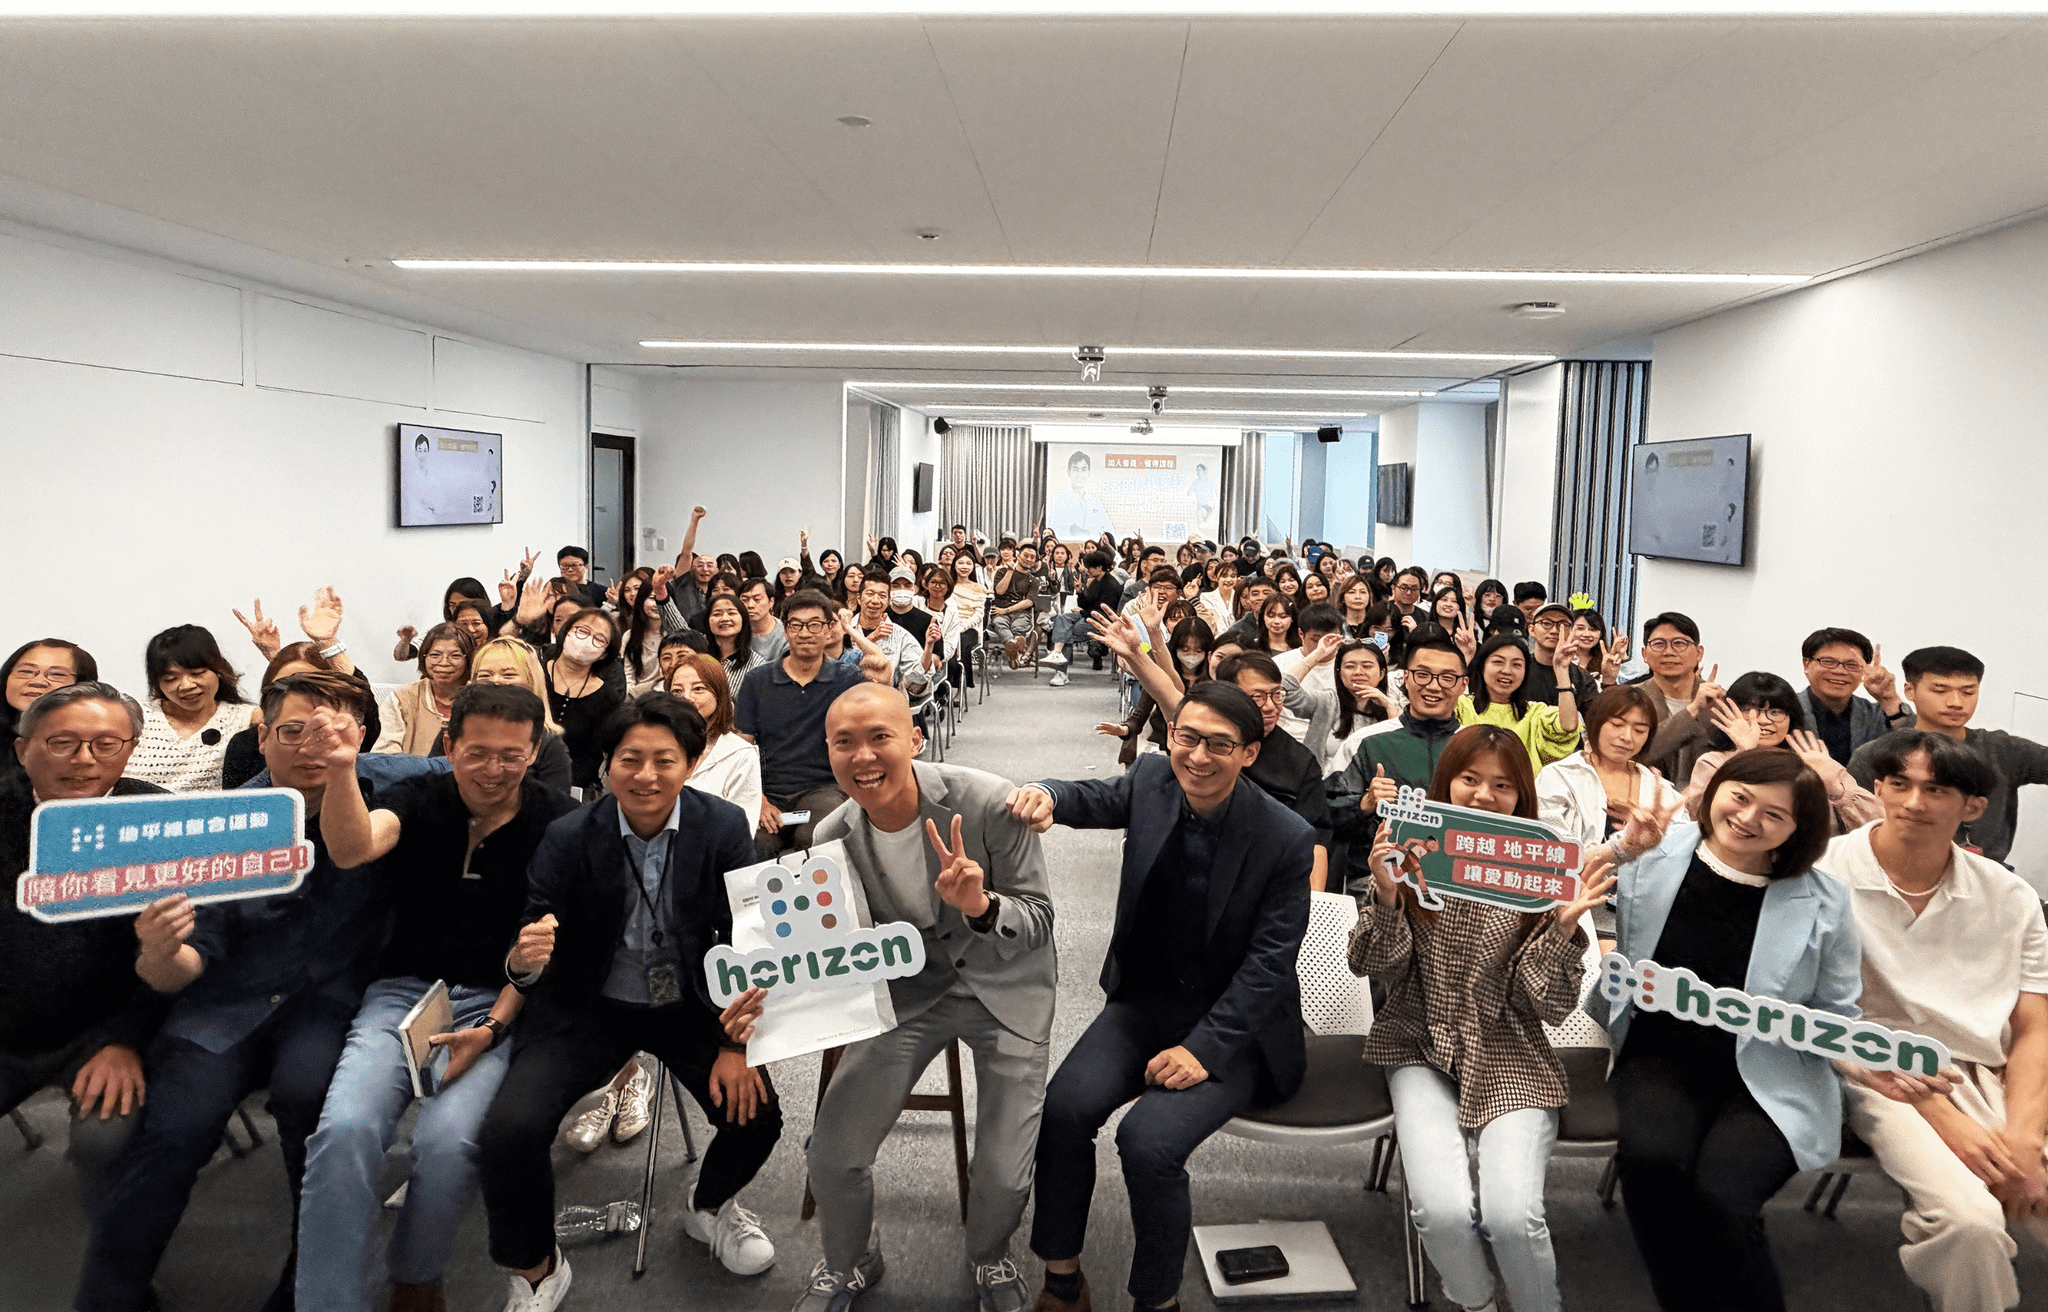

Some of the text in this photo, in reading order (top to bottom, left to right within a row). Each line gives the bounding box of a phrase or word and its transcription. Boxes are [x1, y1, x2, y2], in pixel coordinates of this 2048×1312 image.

[1380, 803, 1439, 825] horizon
[1456, 834, 1566, 864] 跨越 地平線
[1463, 864, 1563, 896] 讓愛動起來
[716, 935, 913, 996] horizon
[1677, 977, 1938, 1077] horizon
